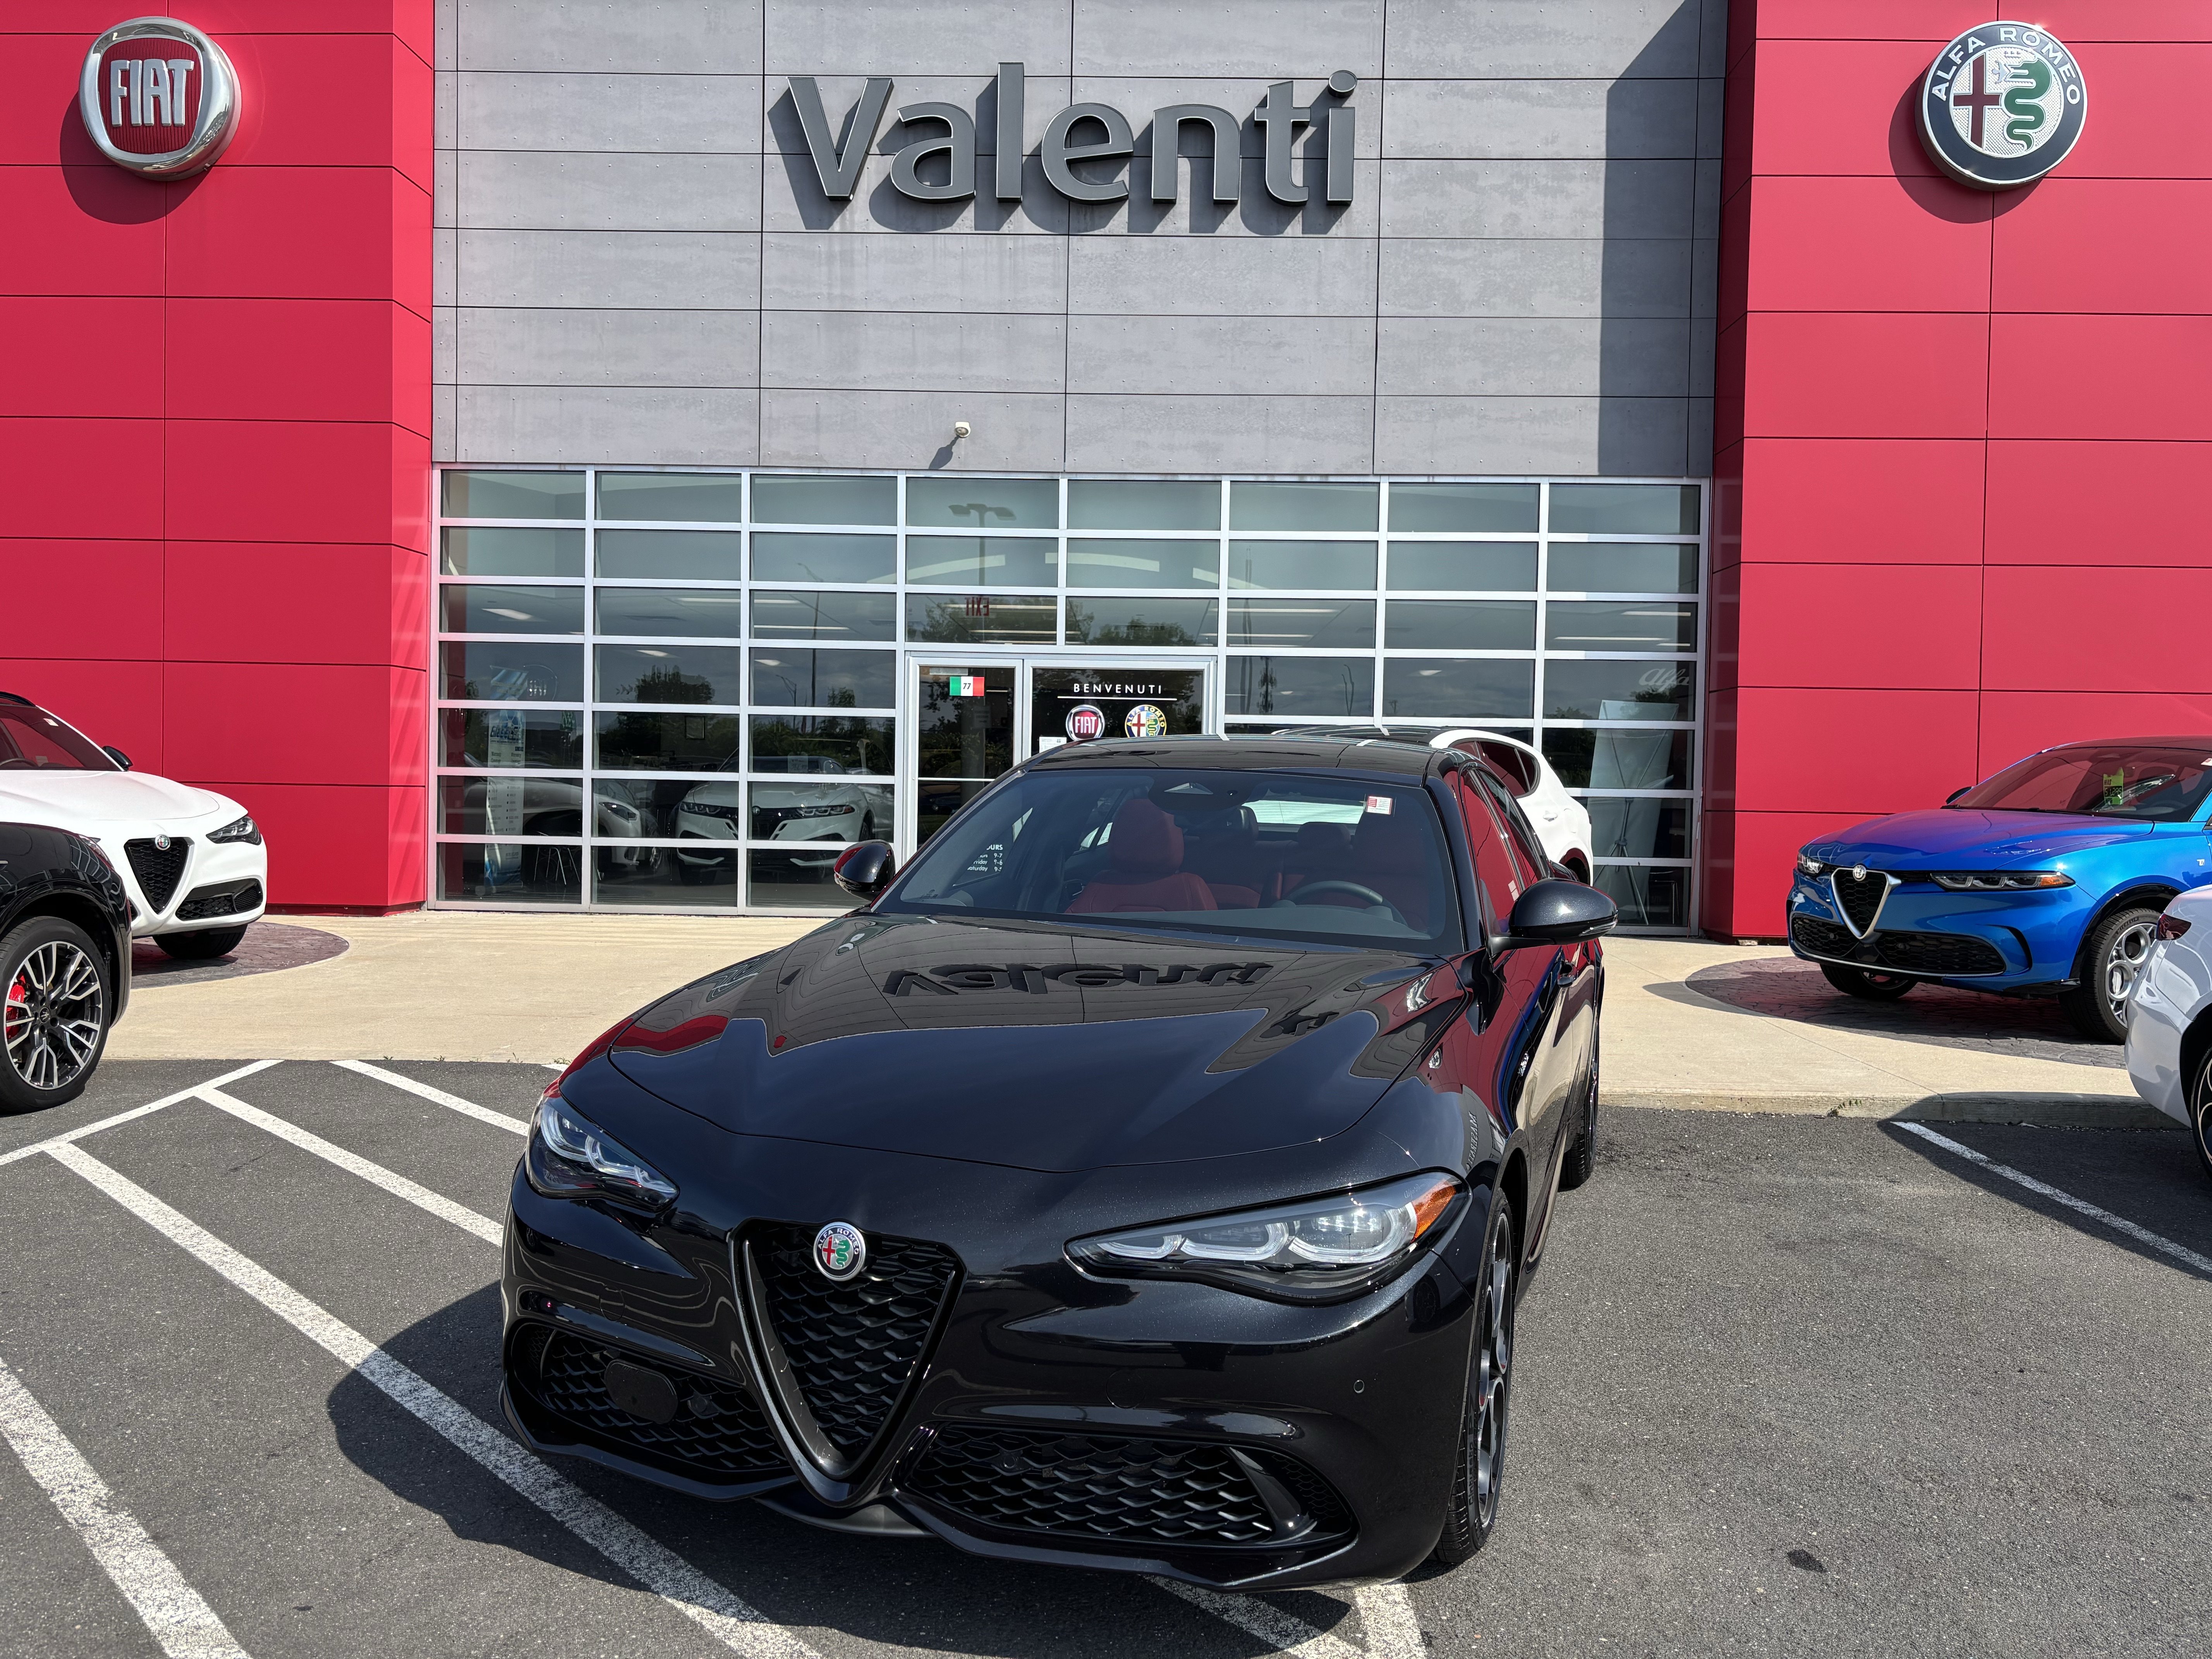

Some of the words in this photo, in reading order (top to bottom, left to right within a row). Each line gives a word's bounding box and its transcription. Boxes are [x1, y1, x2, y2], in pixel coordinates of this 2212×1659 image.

[1931, 36, 1985, 101] ALFA
[1999, 27, 2080, 105] ROMEO
[110, 58, 194, 127] FIAT
[787, 62, 1357, 206] Valenti
[1073, 683, 1162, 694] BENVENUTI
[1075, 716, 1097, 733] FIAT
[1126, 708, 1141, 727] ALFA
[1144, 706, 1165, 727] ROMEO
[818, 1230, 833, 1250] ALFA
[837, 1228, 859, 1255] ROMEO
